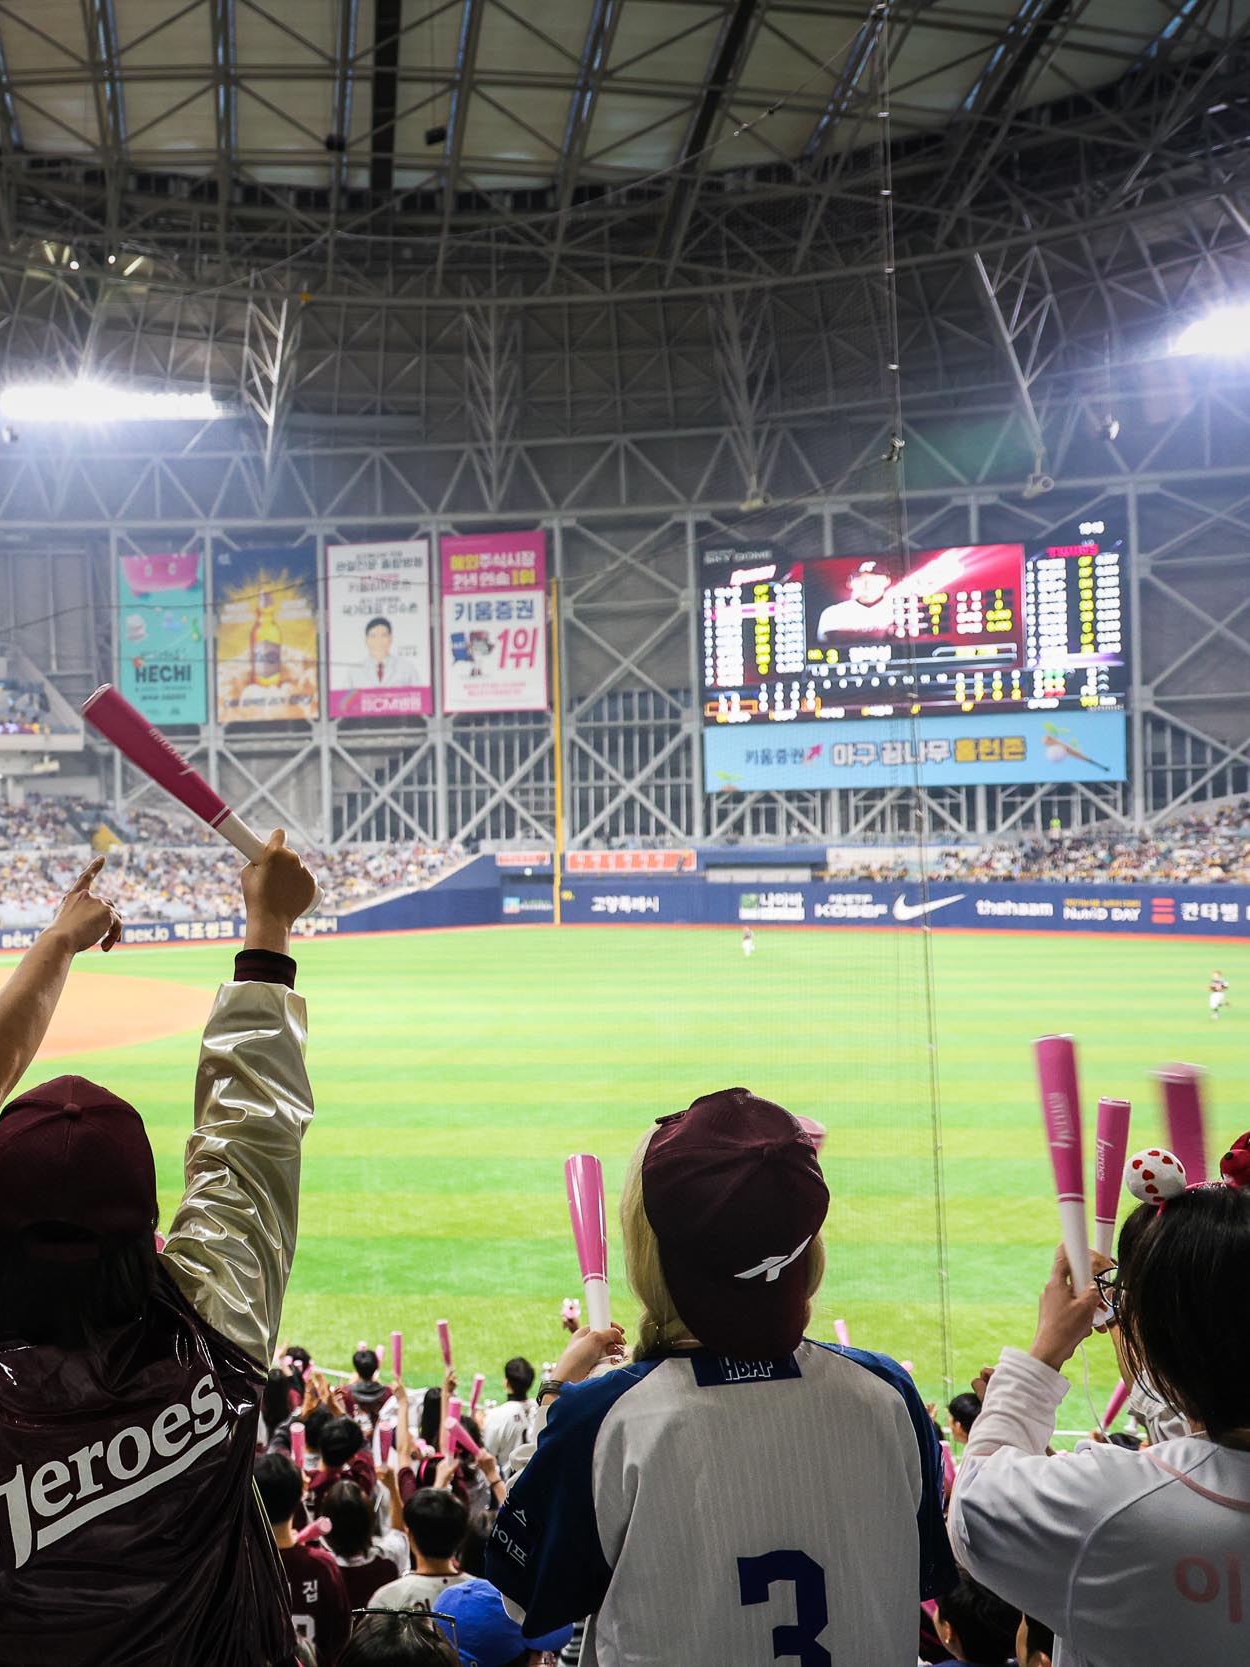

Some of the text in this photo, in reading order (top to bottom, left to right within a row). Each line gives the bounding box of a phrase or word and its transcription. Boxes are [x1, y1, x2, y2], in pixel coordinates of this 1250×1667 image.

[455, 599, 534, 621] 키움증권
[498, 627, 538, 669] 1위
[135, 663, 191, 684] HECHI
[833, 742, 877, 766] 야구
[1111, 908, 1141, 921] DAY
[737, 1549, 833, 1667] 3
